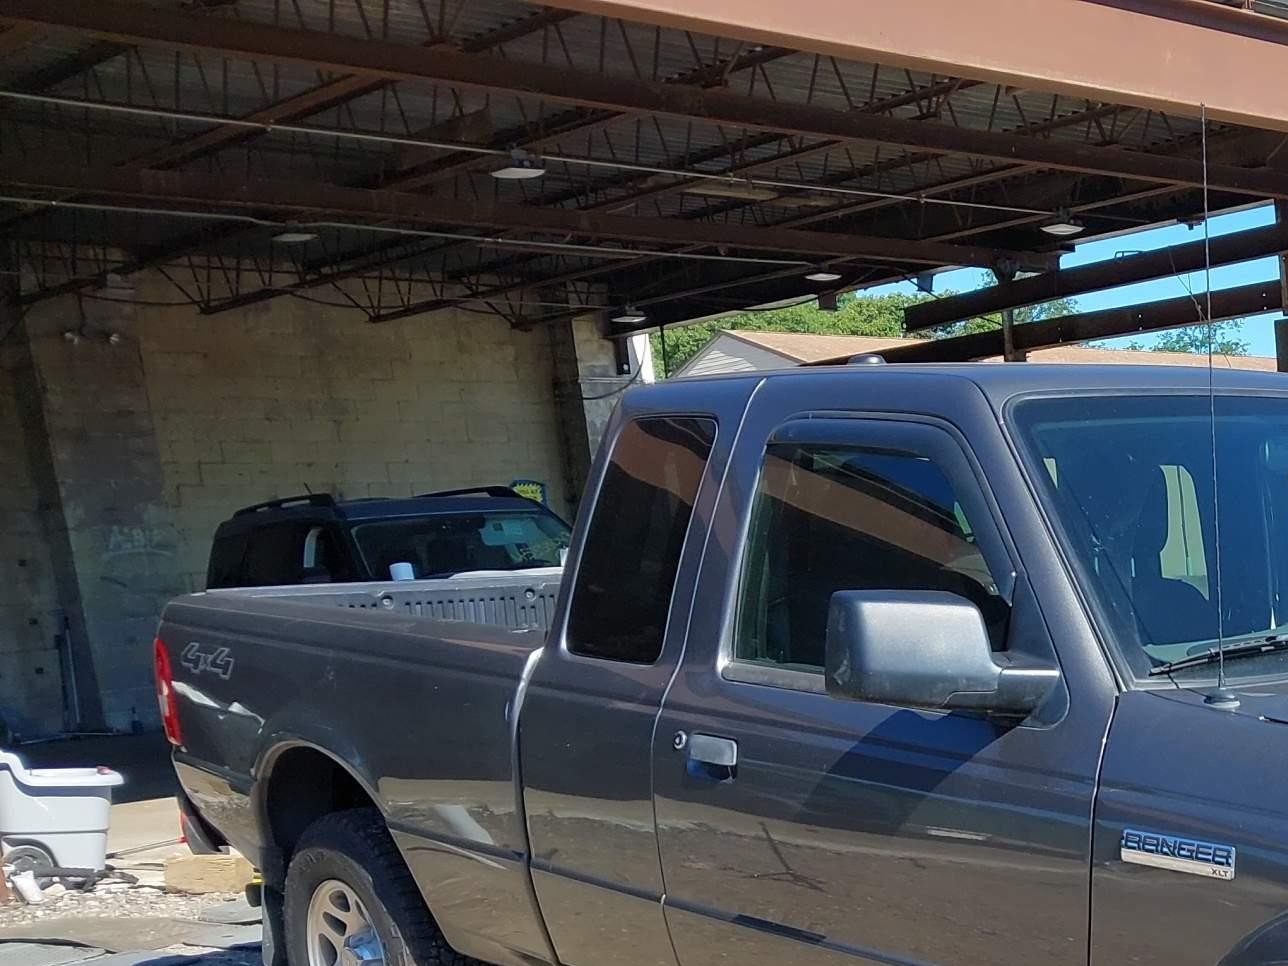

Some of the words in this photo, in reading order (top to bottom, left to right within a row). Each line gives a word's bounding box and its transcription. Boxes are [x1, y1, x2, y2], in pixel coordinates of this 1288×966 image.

[180, 641, 234, 681] 4x4
[1123, 831, 1233, 867] RANGER
[1210, 867, 1230, 878] XLT
